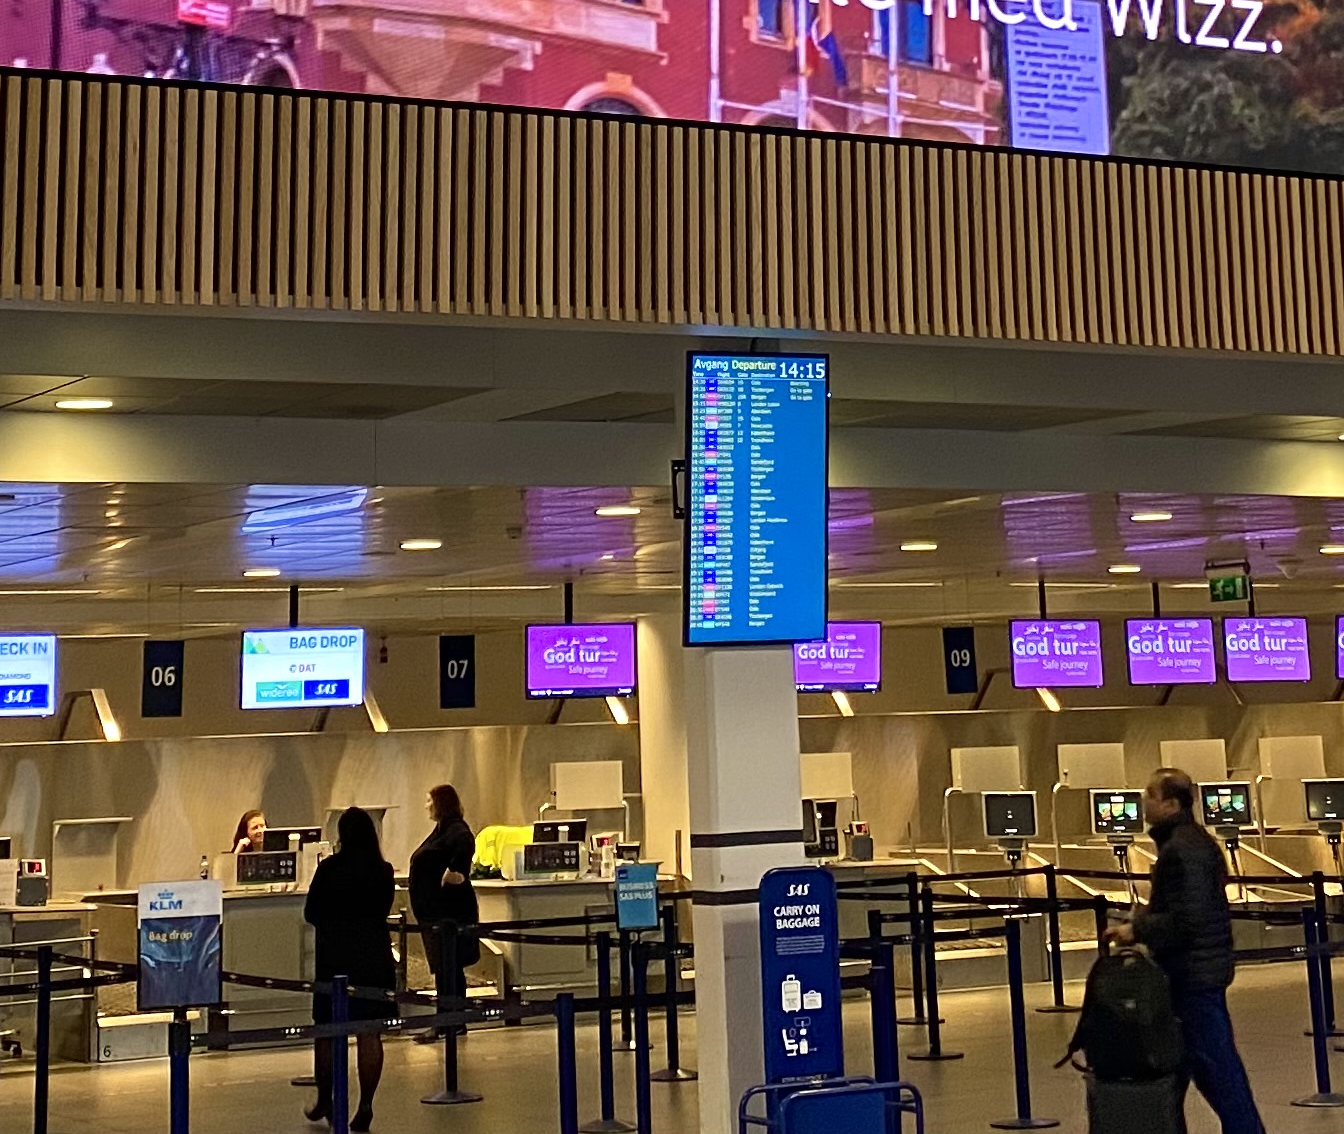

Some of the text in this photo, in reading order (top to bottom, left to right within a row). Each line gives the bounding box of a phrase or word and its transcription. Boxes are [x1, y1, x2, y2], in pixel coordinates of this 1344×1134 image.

[694, 358, 728, 371] Avgang
[731, 359, 776, 371] Departure
[779, 362, 826, 379] 14:15
[34, 642, 48, 655] IN
[289, 635, 358, 649] BAG DROP
[1012, 637, 1049, 656] God
[1053, 639, 1079, 656] tur
[1128, 635, 1192, 653] God tur
[1226, 633, 1288, 652] God tur
[543, 647, 601, 664] God tur
[798, 645, 850, 659] God tur
[951, 649, 970, 667] 09
[299, 664, 316, 673] DAT
[447, 660, 468, 679] 07
[151, 666, 175, 687] 06
[4, 689, 34, 703] SAS
[787, 884, 810, 896] SAS
[149, 900, 182, 911] KLM
[774, 904, 820, 917] CARRY ON
[776, 917, 820, 929] BAGGAGE
[149, 929, 192, 942] Bag drop
